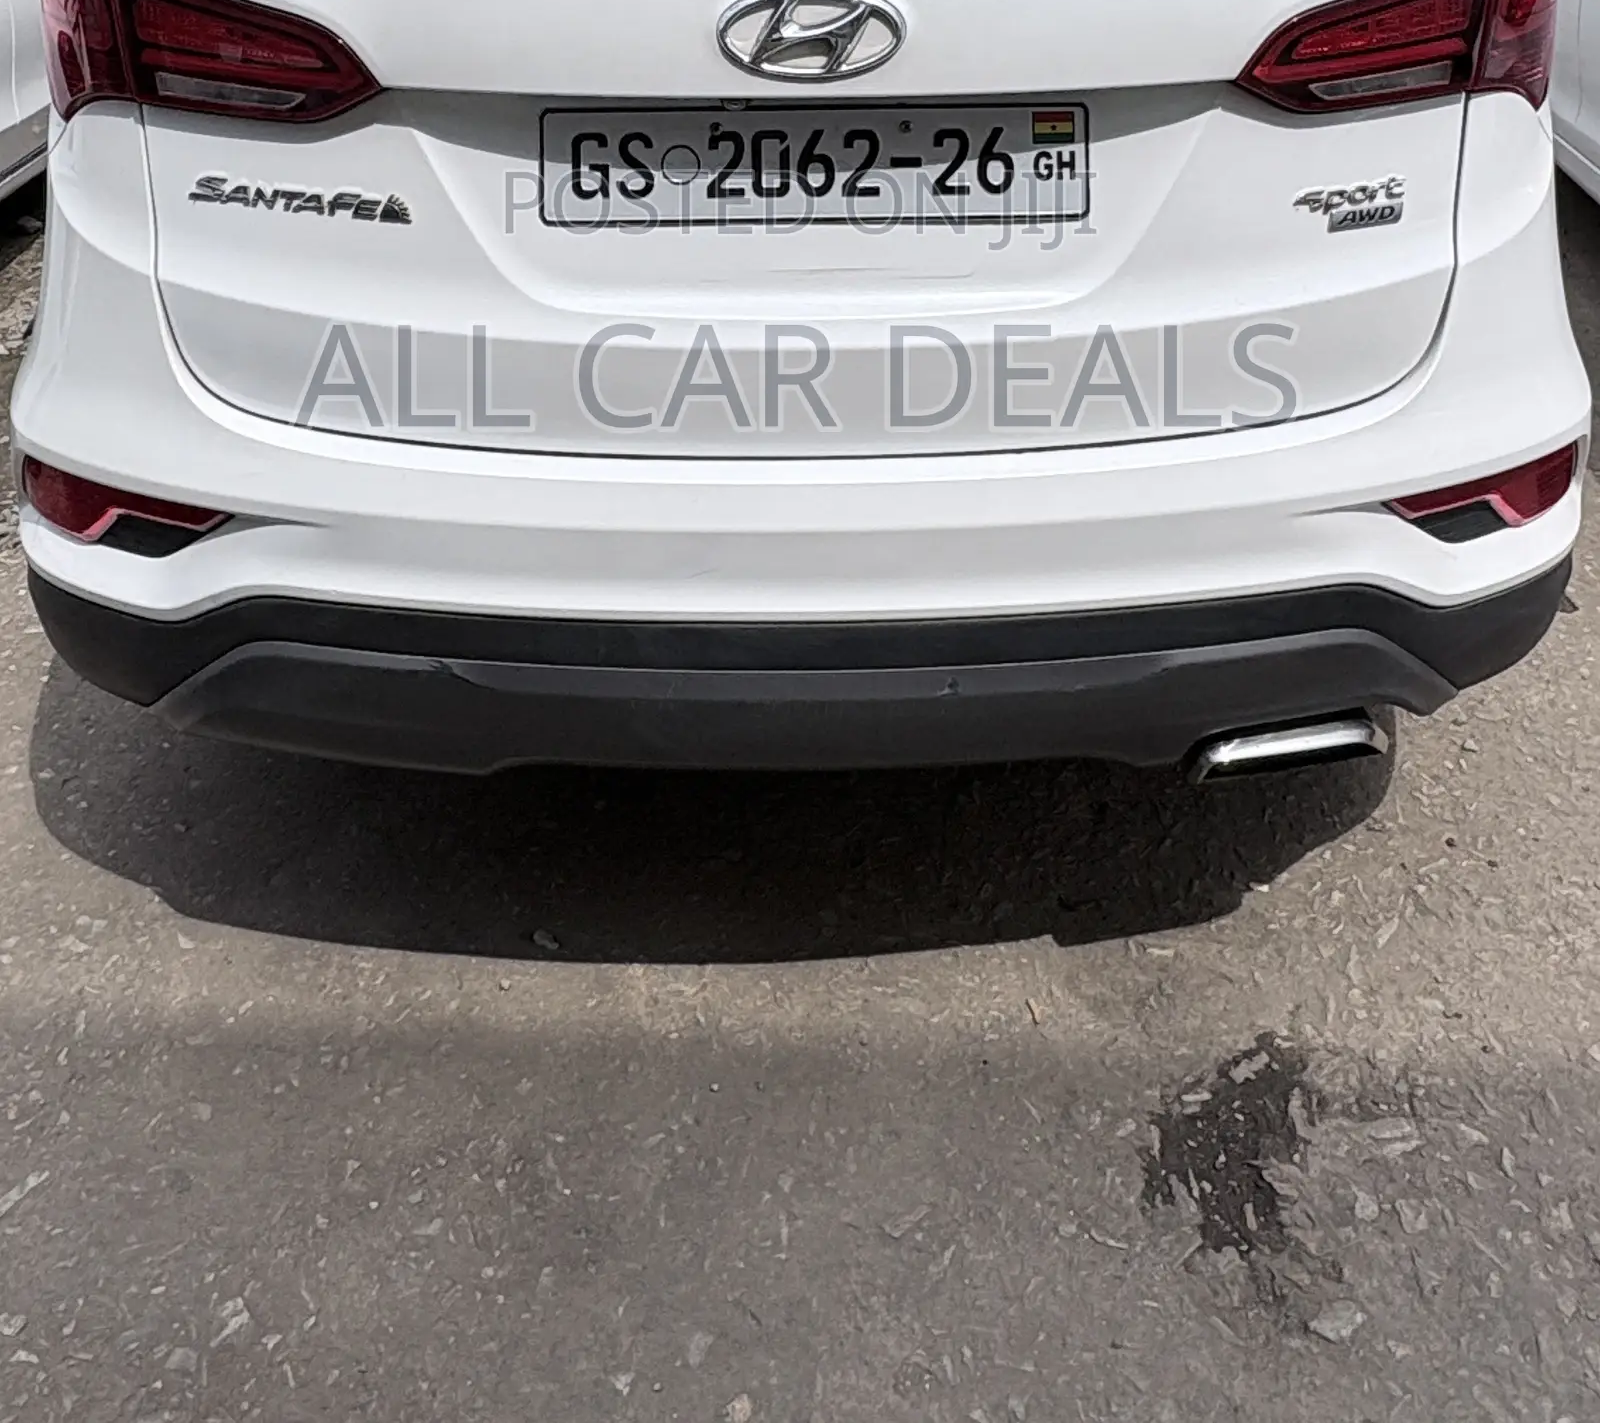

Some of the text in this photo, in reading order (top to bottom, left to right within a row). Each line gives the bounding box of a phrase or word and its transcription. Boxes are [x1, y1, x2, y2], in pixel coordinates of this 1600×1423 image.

[571, 126, 1014, 200] GS 2062-26
[1033, 150, 1077, 181] GH
[1337, 205, 1396, 225] AWD
